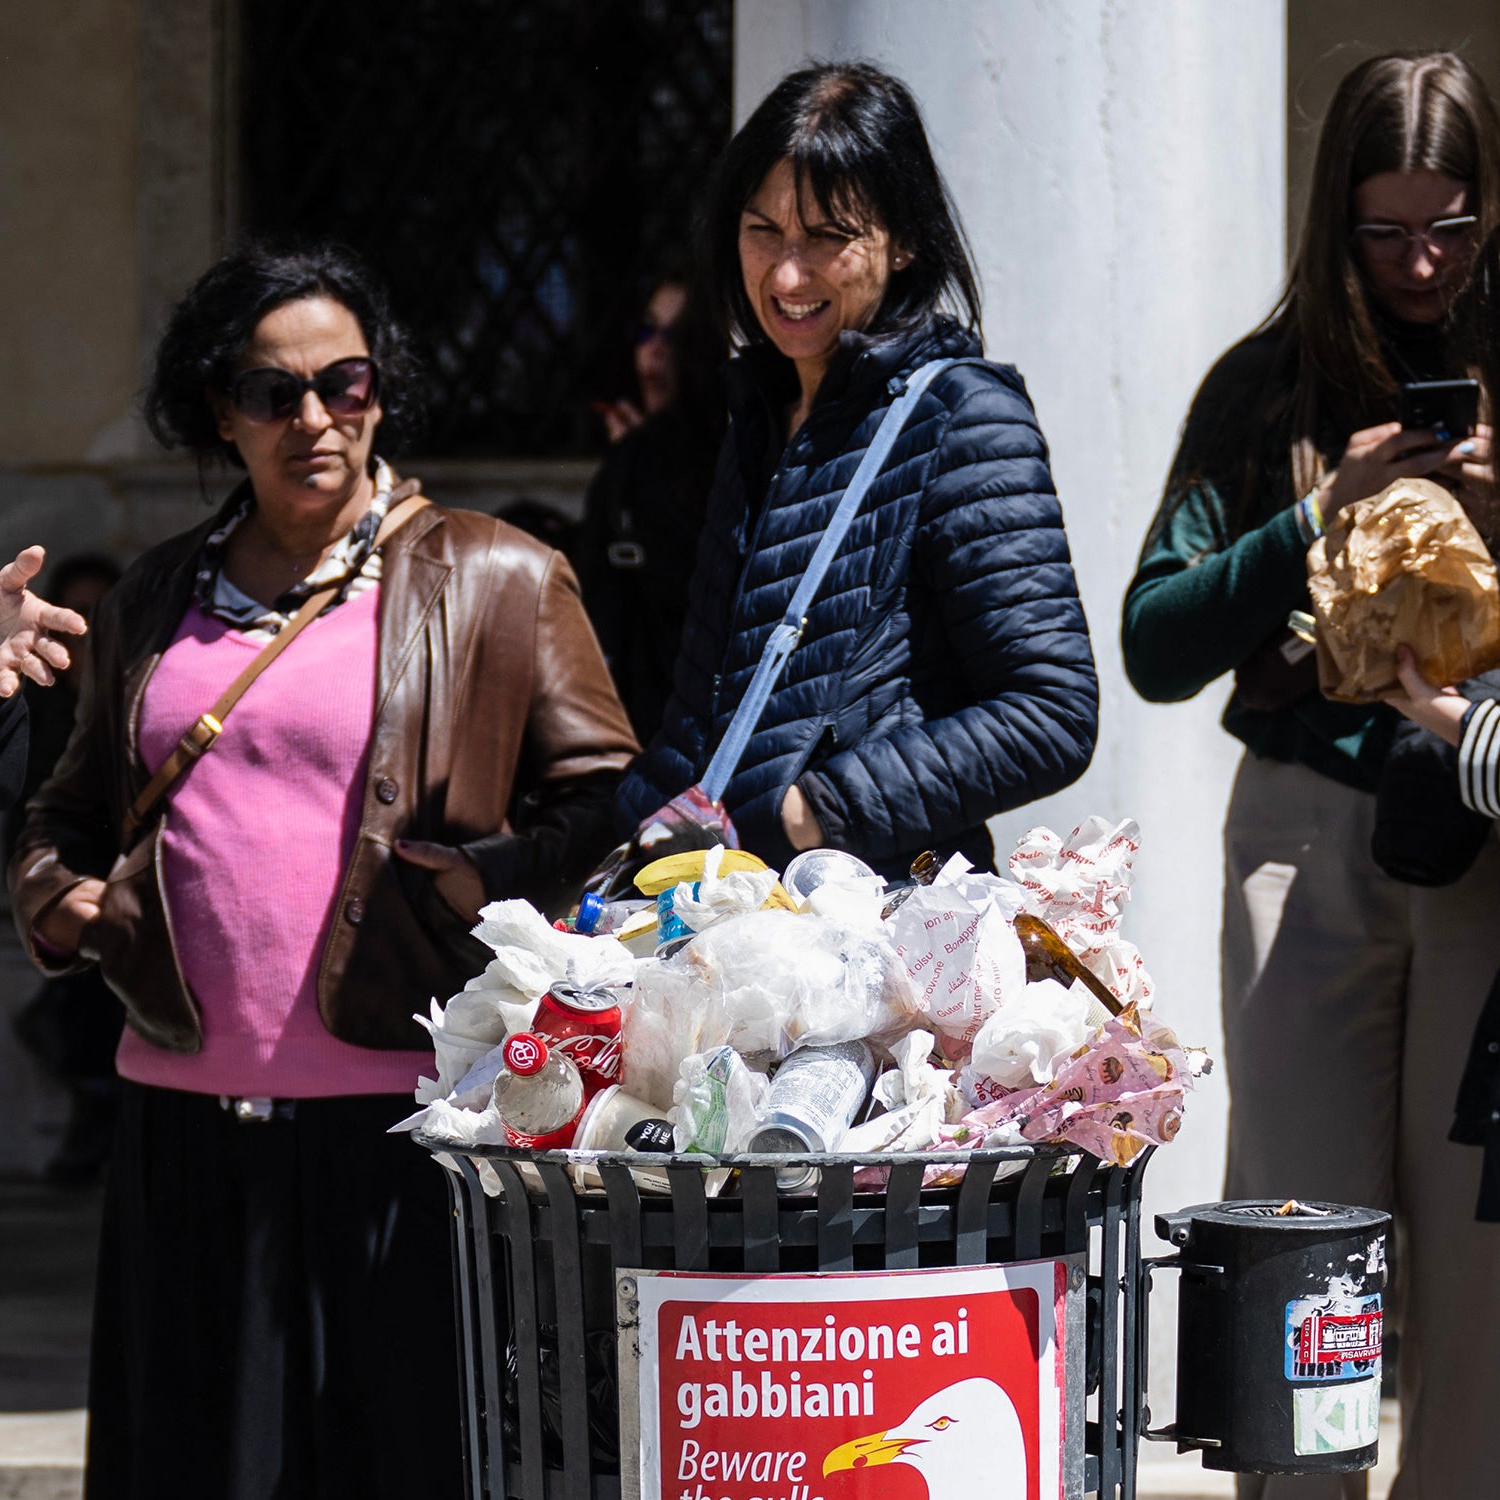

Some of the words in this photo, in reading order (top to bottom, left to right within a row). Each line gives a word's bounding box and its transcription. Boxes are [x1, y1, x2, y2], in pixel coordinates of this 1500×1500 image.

[639, 1122, 655, 1142] YOU
[658, 1130, 672, 1146] ME
[675, 1314, 921, 1362] Attenzione
[931, 1307, 968, 1356] ai
[676, 1369, 874, 1429] gabbiani
[677, 1439, 807, 1482] Beware
